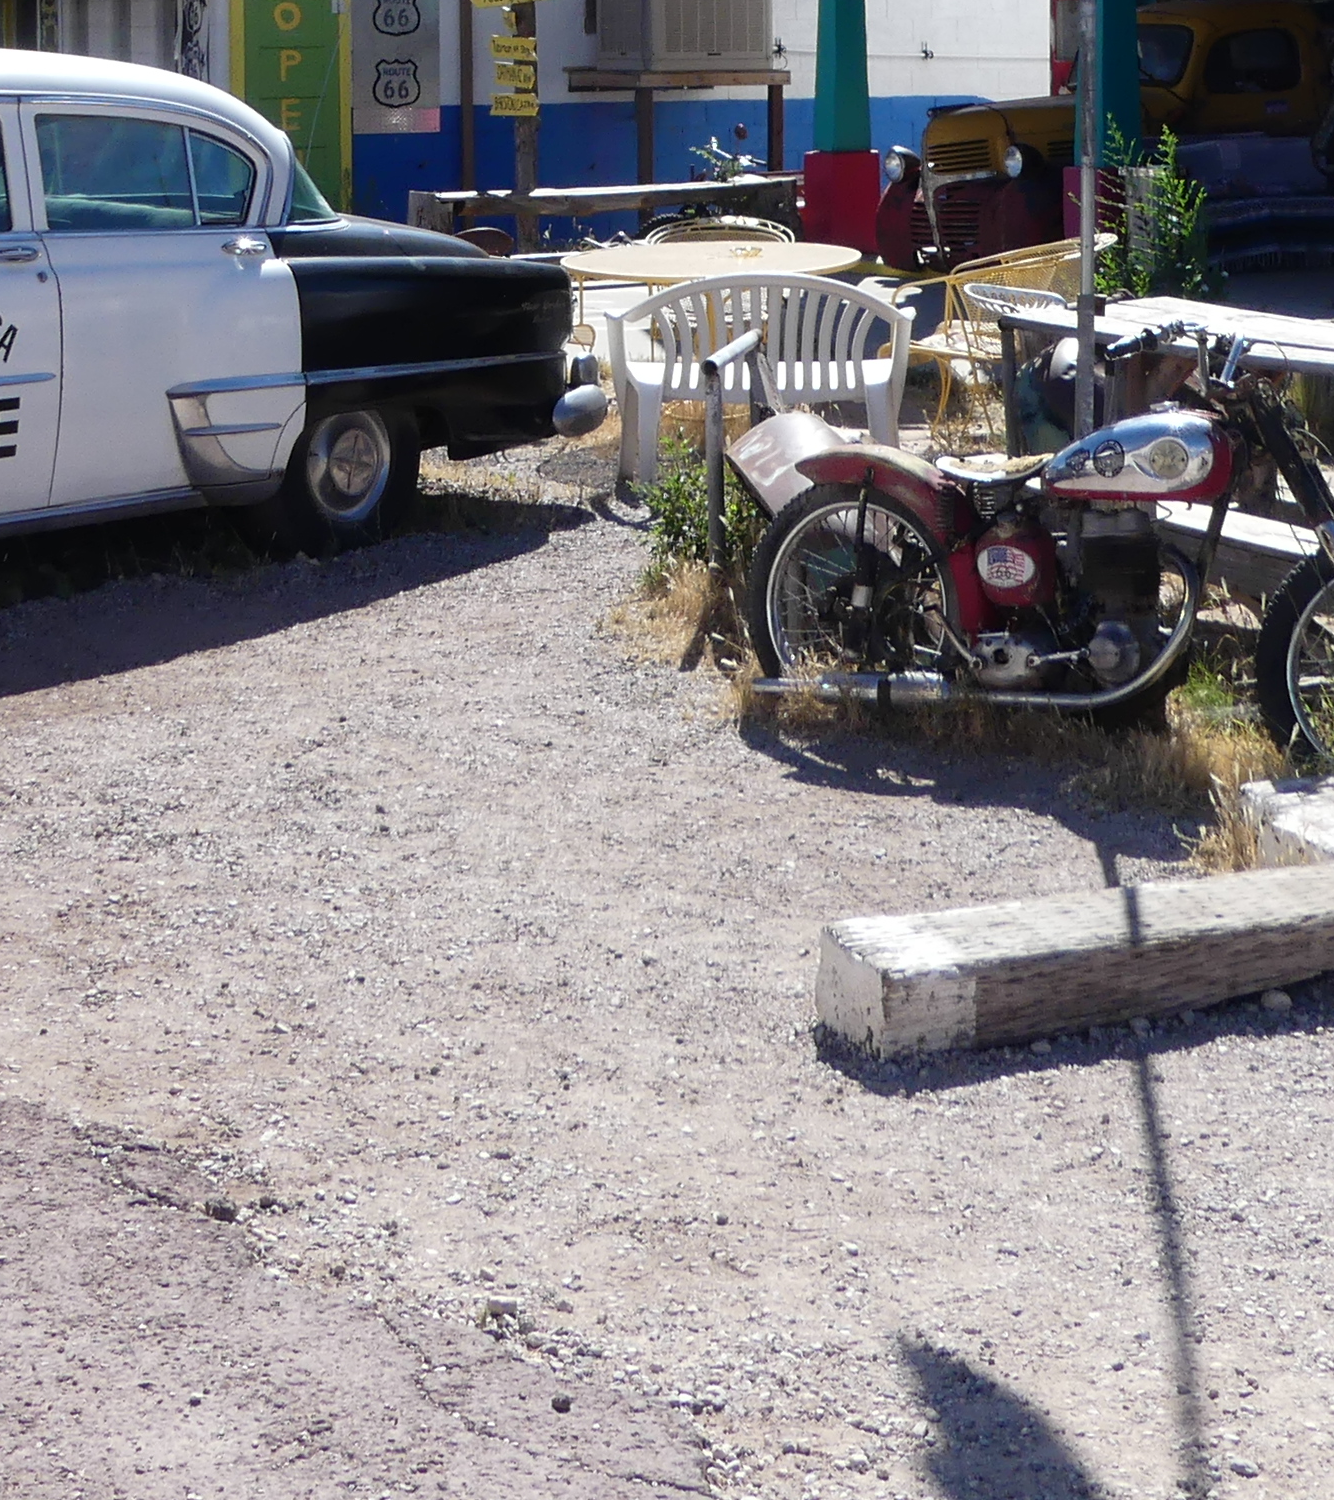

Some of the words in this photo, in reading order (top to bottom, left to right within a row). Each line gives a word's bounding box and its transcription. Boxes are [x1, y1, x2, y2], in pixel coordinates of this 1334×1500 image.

[384, 9, 410, 28] 66
[382, 67, 412, 77] ROUTE
[384, 81, 410, 100] 66
